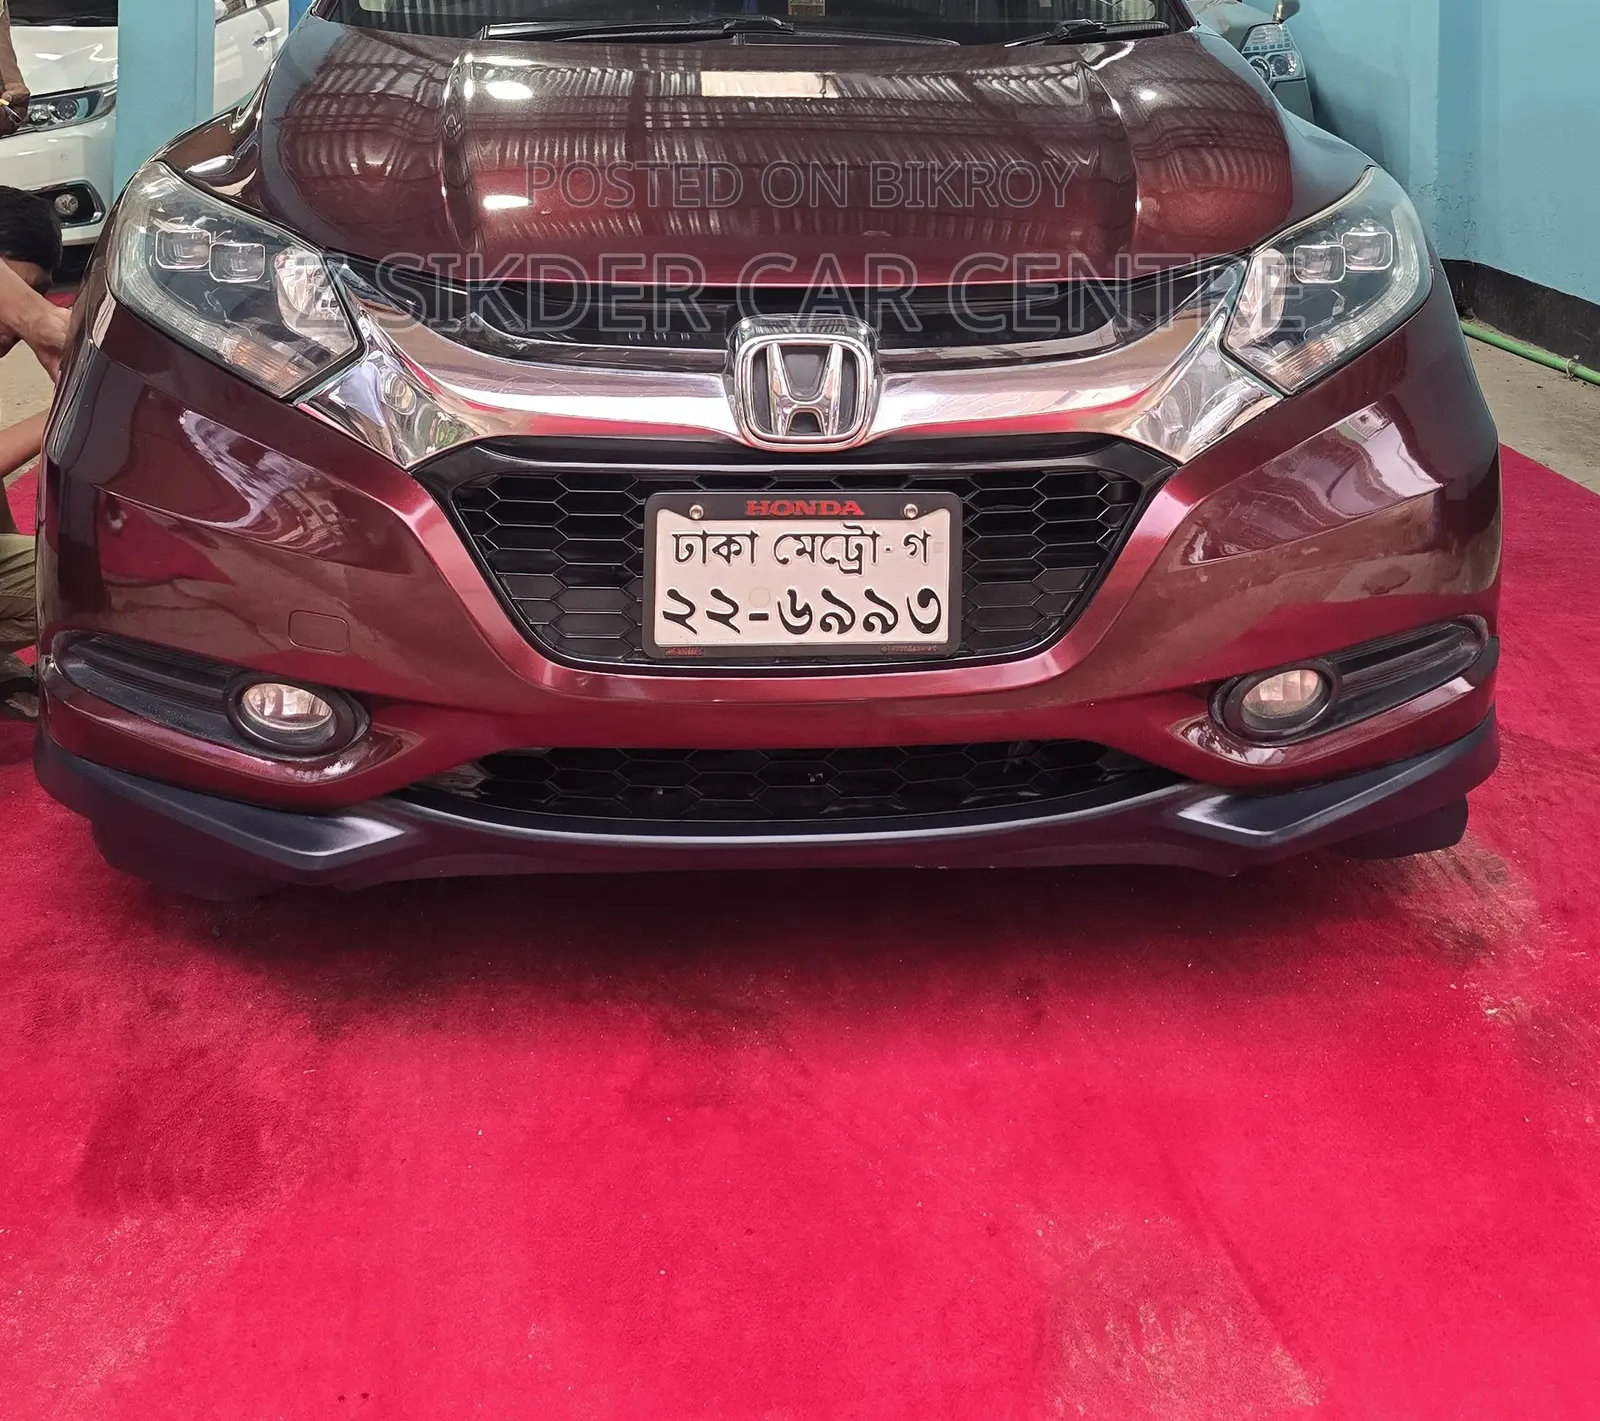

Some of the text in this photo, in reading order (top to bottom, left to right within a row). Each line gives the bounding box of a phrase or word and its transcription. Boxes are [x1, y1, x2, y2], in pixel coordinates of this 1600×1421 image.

[746, 499, 865, 517] HONDA
[671, 529, 760, 565] ঢাকা
[661, 587, 942, 635] ২২-৬৯৯৩
